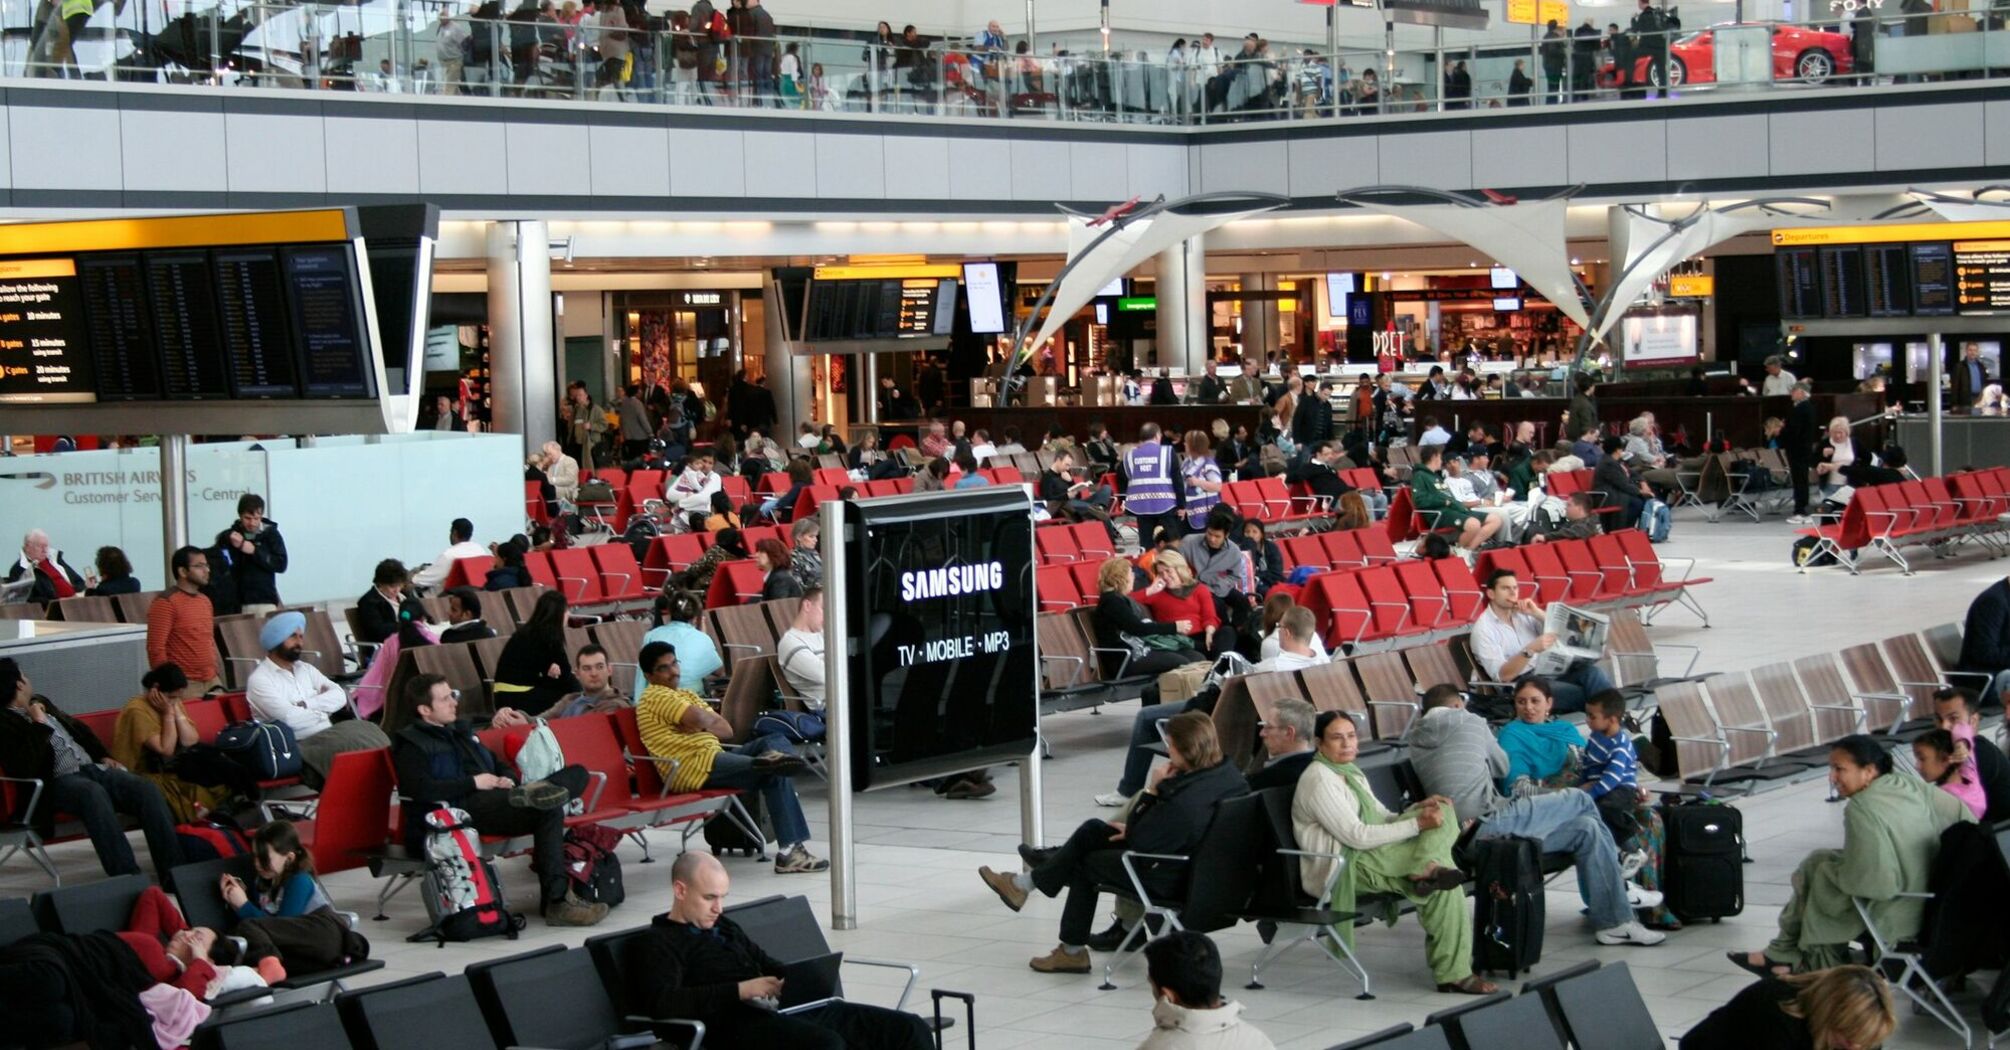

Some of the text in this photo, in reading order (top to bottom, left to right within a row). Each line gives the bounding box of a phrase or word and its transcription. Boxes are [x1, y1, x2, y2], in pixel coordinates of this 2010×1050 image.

[1830, 0, 1883, 11] SOY
[1784, 233, 1830, 242] Departures
[1372, 331, 1405, 357] PRET
[63, 470, 197, 487] BRITISH AIRS
[64, 490, 129, 505] Customer
[202, 487, 250, 501] Central
[901, 561, 1002, 601] SAMSUNG
[897, 645, 916, 667] TV
[926, 636, 974, 663] MOBILE
[984, 630, 1010, 654] MP3
